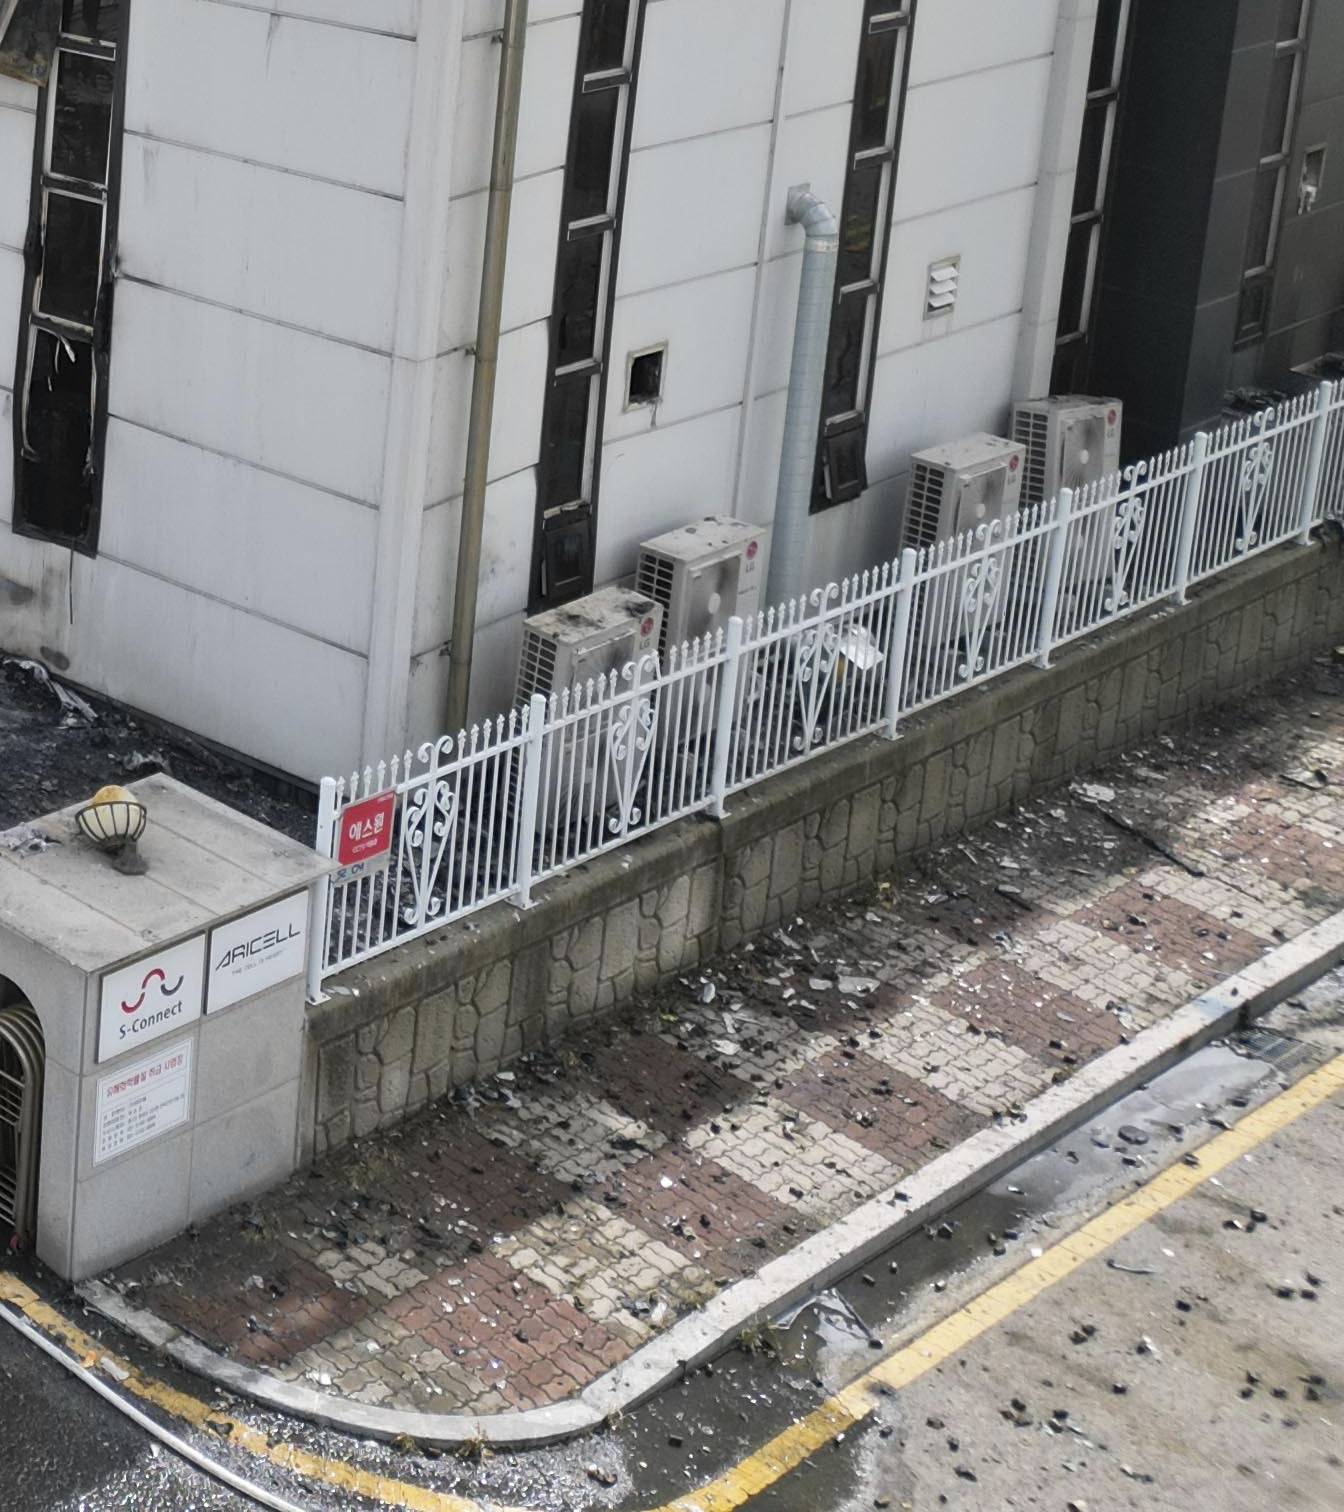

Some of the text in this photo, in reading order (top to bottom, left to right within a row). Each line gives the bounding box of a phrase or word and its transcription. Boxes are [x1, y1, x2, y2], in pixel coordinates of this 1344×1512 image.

[639, 639, 651, 651] LG
[349, 812, 384, 840] 에스원
[215, 923, 300, 971] ARICELL
[119, 999, 184, 1040] S-Connect
